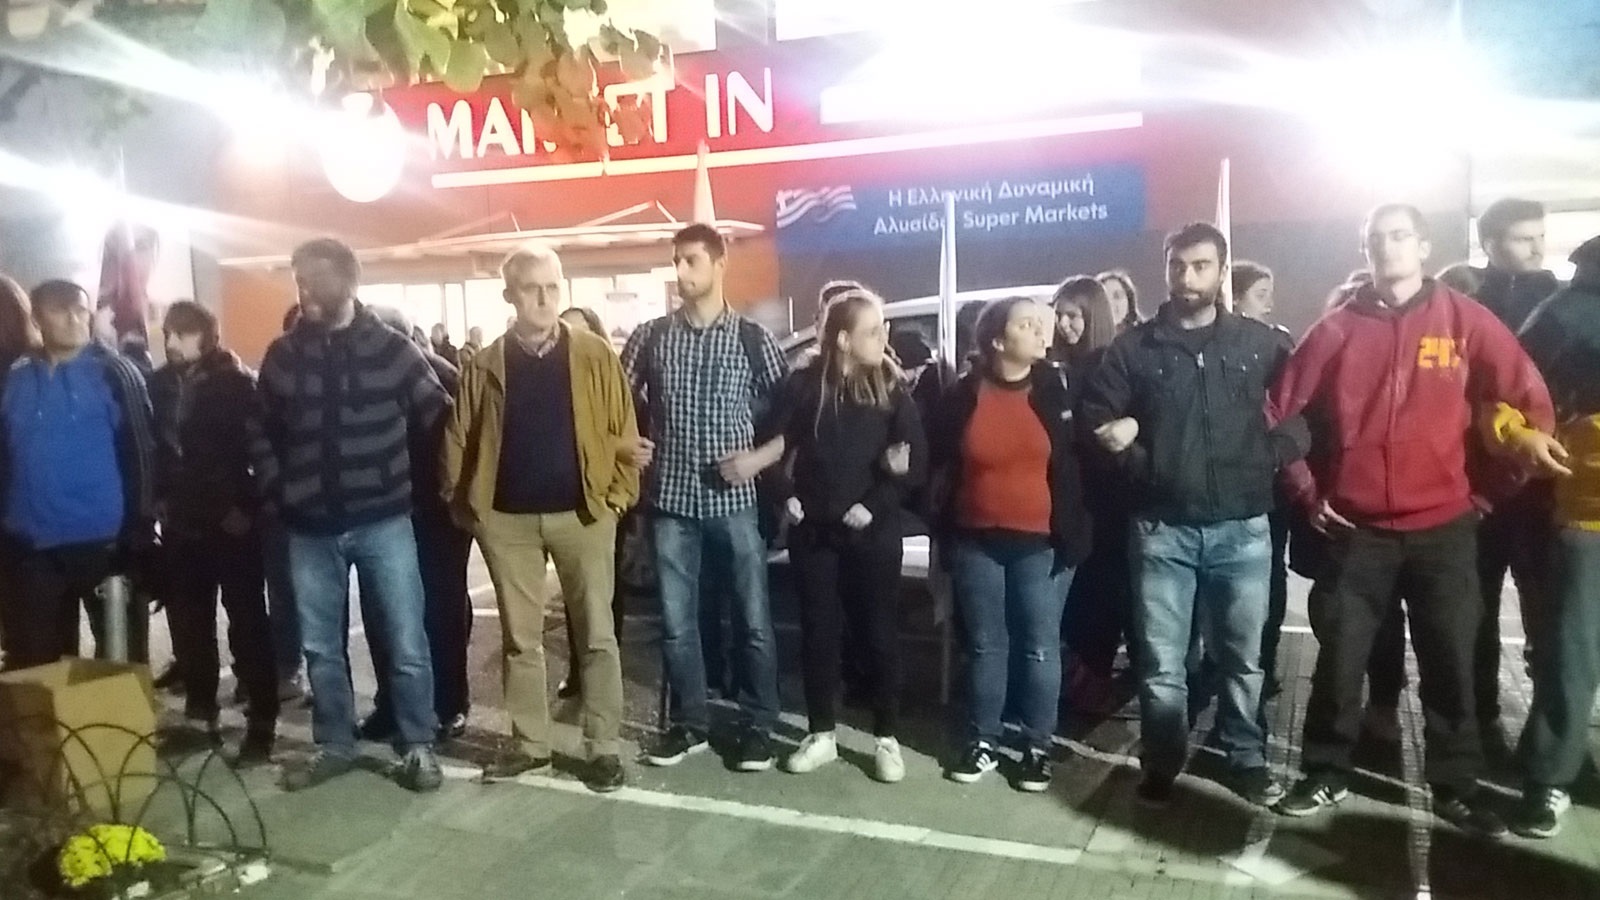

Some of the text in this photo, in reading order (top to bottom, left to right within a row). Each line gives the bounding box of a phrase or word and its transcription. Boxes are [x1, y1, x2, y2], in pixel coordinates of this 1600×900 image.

[705, 67, 774, 138] IN
[998, 172, 1095, 200] Δυναμική
[963, 210, 1020, 232] Super
[1025, 202, 1108, 224] Markets
